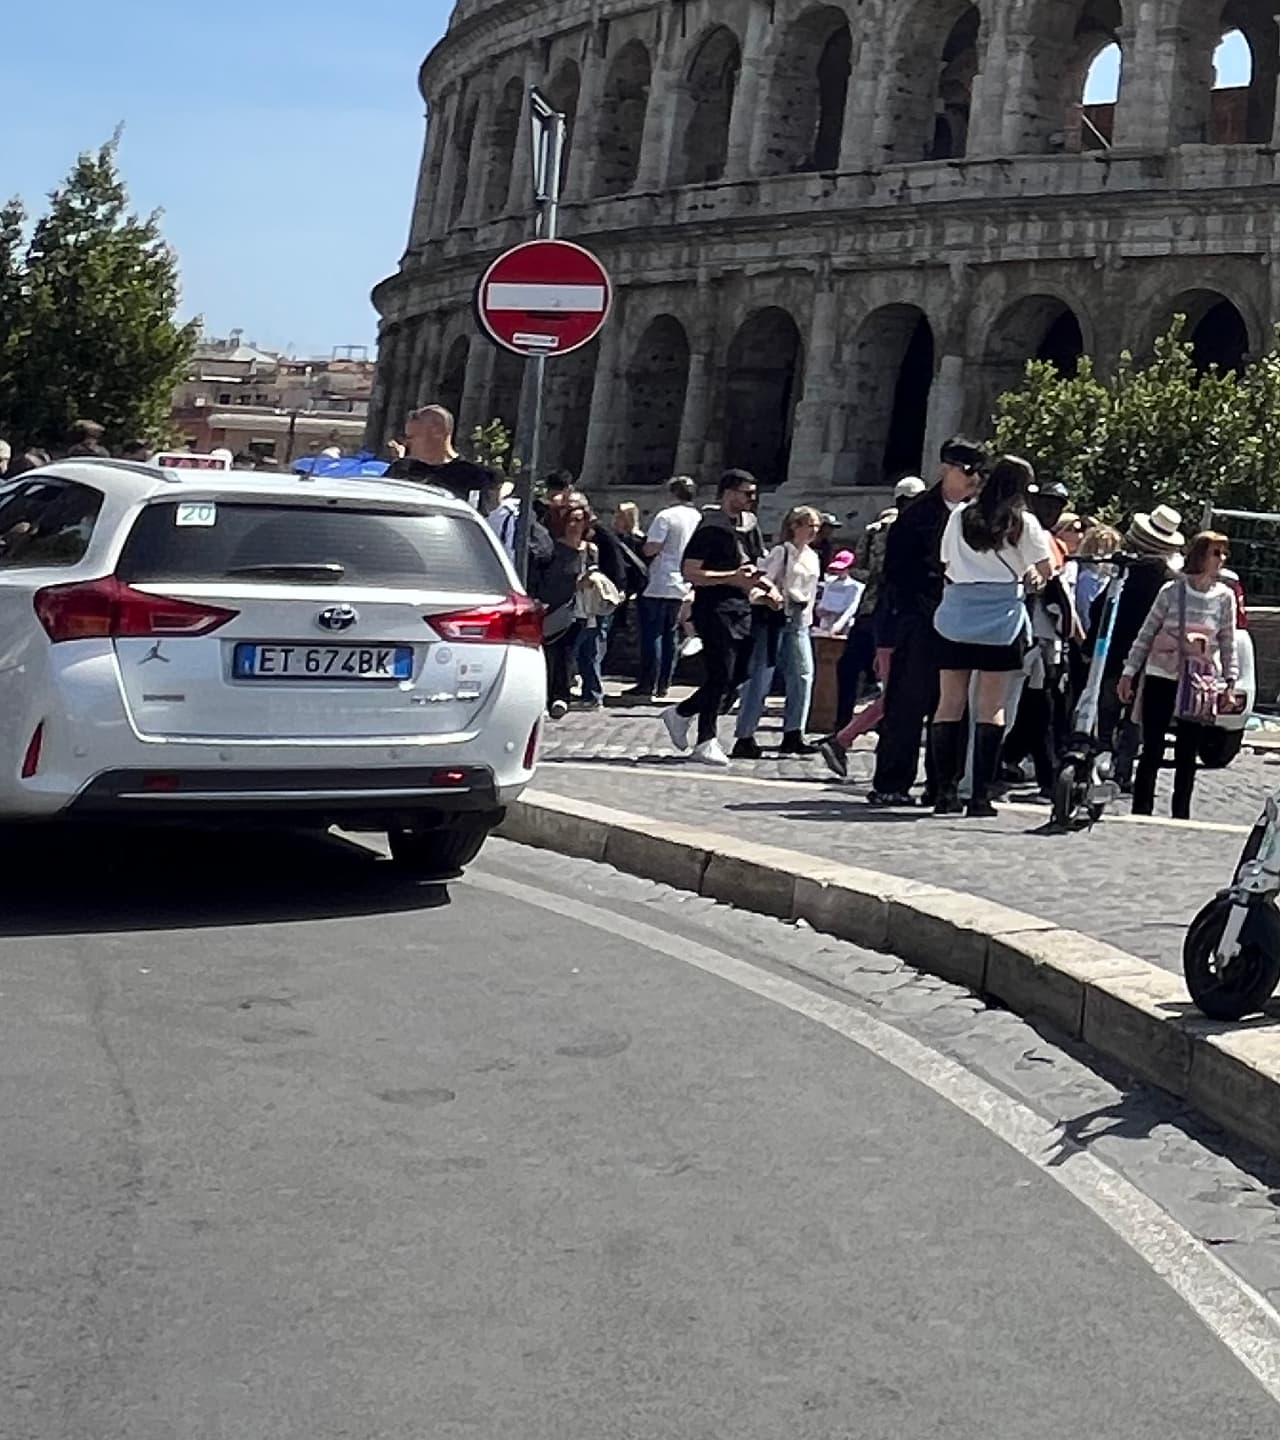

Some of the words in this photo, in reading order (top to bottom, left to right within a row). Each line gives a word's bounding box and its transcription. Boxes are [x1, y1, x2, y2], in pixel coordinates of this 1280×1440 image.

[180, 506, 212, 521] 20
[259, 648, 295, 672] ET
[304, 649, 390, 674] 674BK
